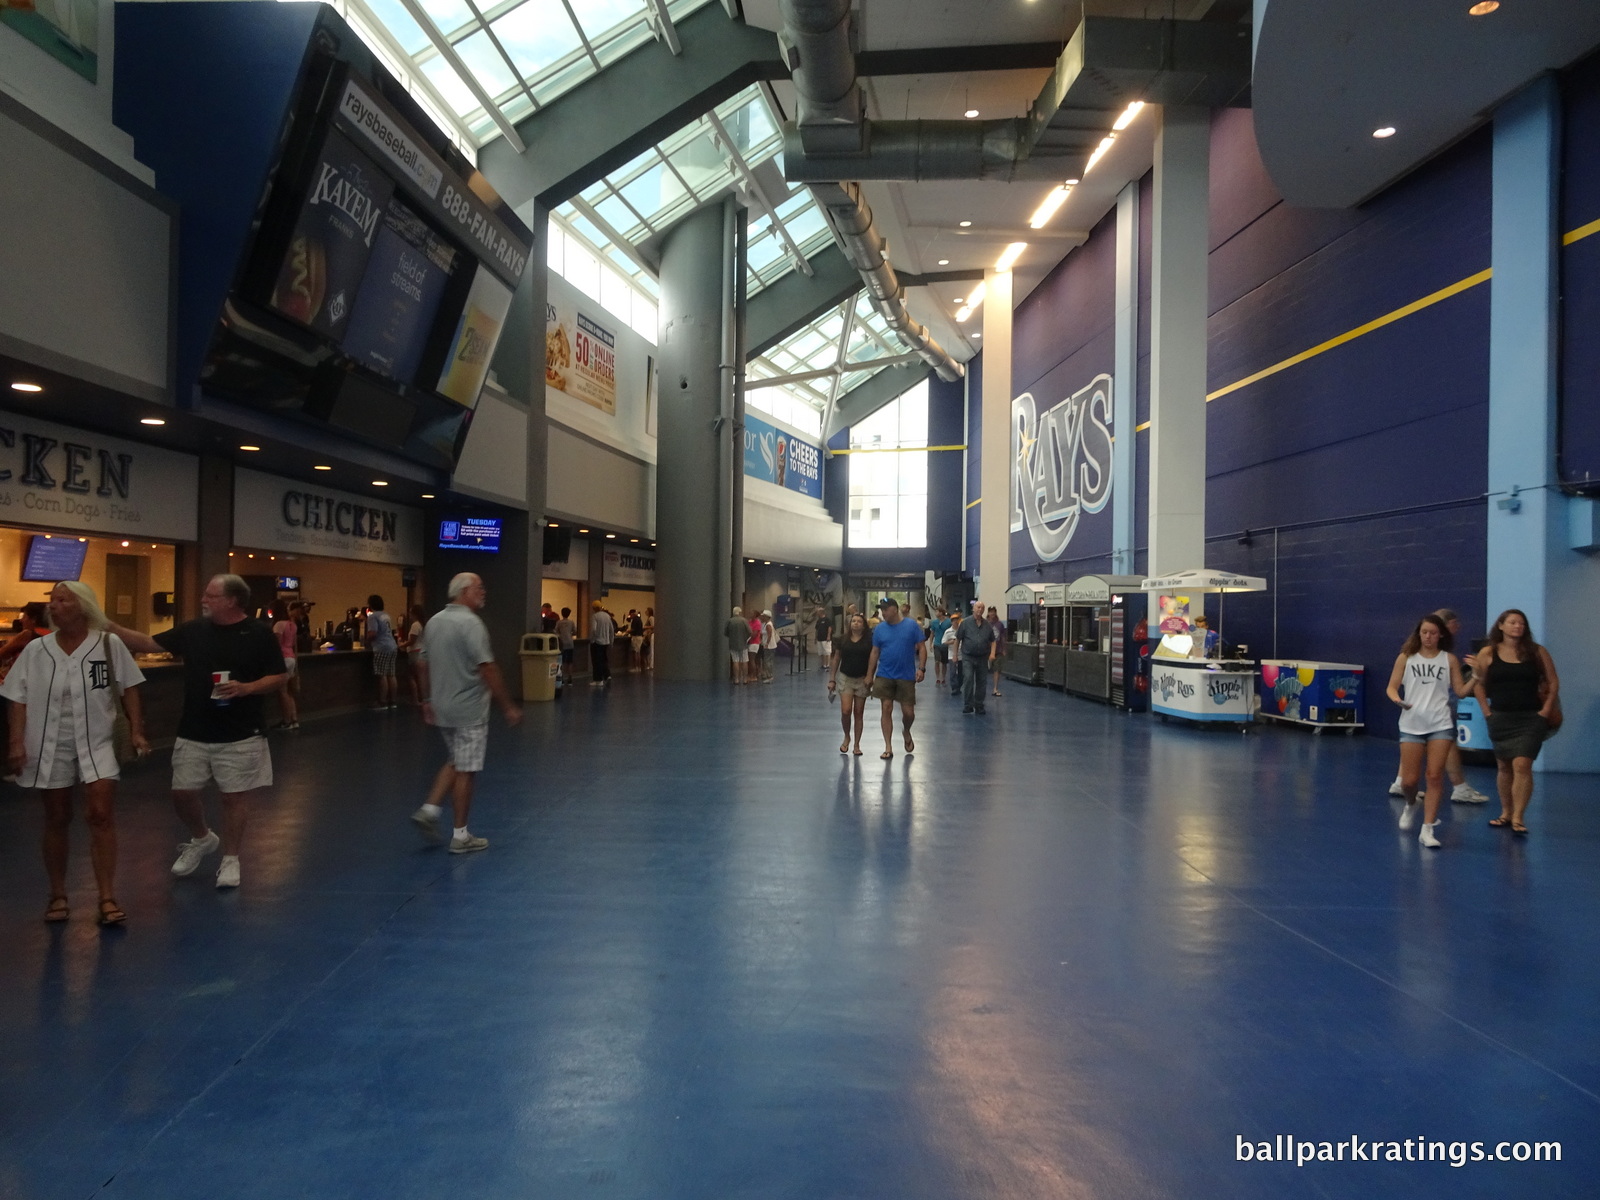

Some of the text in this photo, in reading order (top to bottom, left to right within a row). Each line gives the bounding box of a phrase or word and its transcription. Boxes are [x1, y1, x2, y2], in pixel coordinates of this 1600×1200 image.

[344, 92, 439, 191] raysbaseball.com
[310, 162, 382, 248] KAYEM
[442, 184, 526, 278] 888-FAN-RAYS
[397, 251, 428, 285] field of
[576, 332, 589, 367] 50
[594, 343, 615, 368] ONLINE
[594, 359, 615, 382] ORDERS
[790, 438, 819, 468] CHEERS
[1010, 373, 1114, 561] RAYS
[790, 458, 818, 480] TO THE RAYS
[24, 490, 62, 513] Corn
[65, 497, 100, 522] Dogs
[283, 490, 399, 543] CHICKEN
[467, 518, 497, 526] TUESDAY
[864, 579, 890, 588] TEAM
[88, 660, 110, 691] D
[1411, 663, 1446, 681] NIKE
